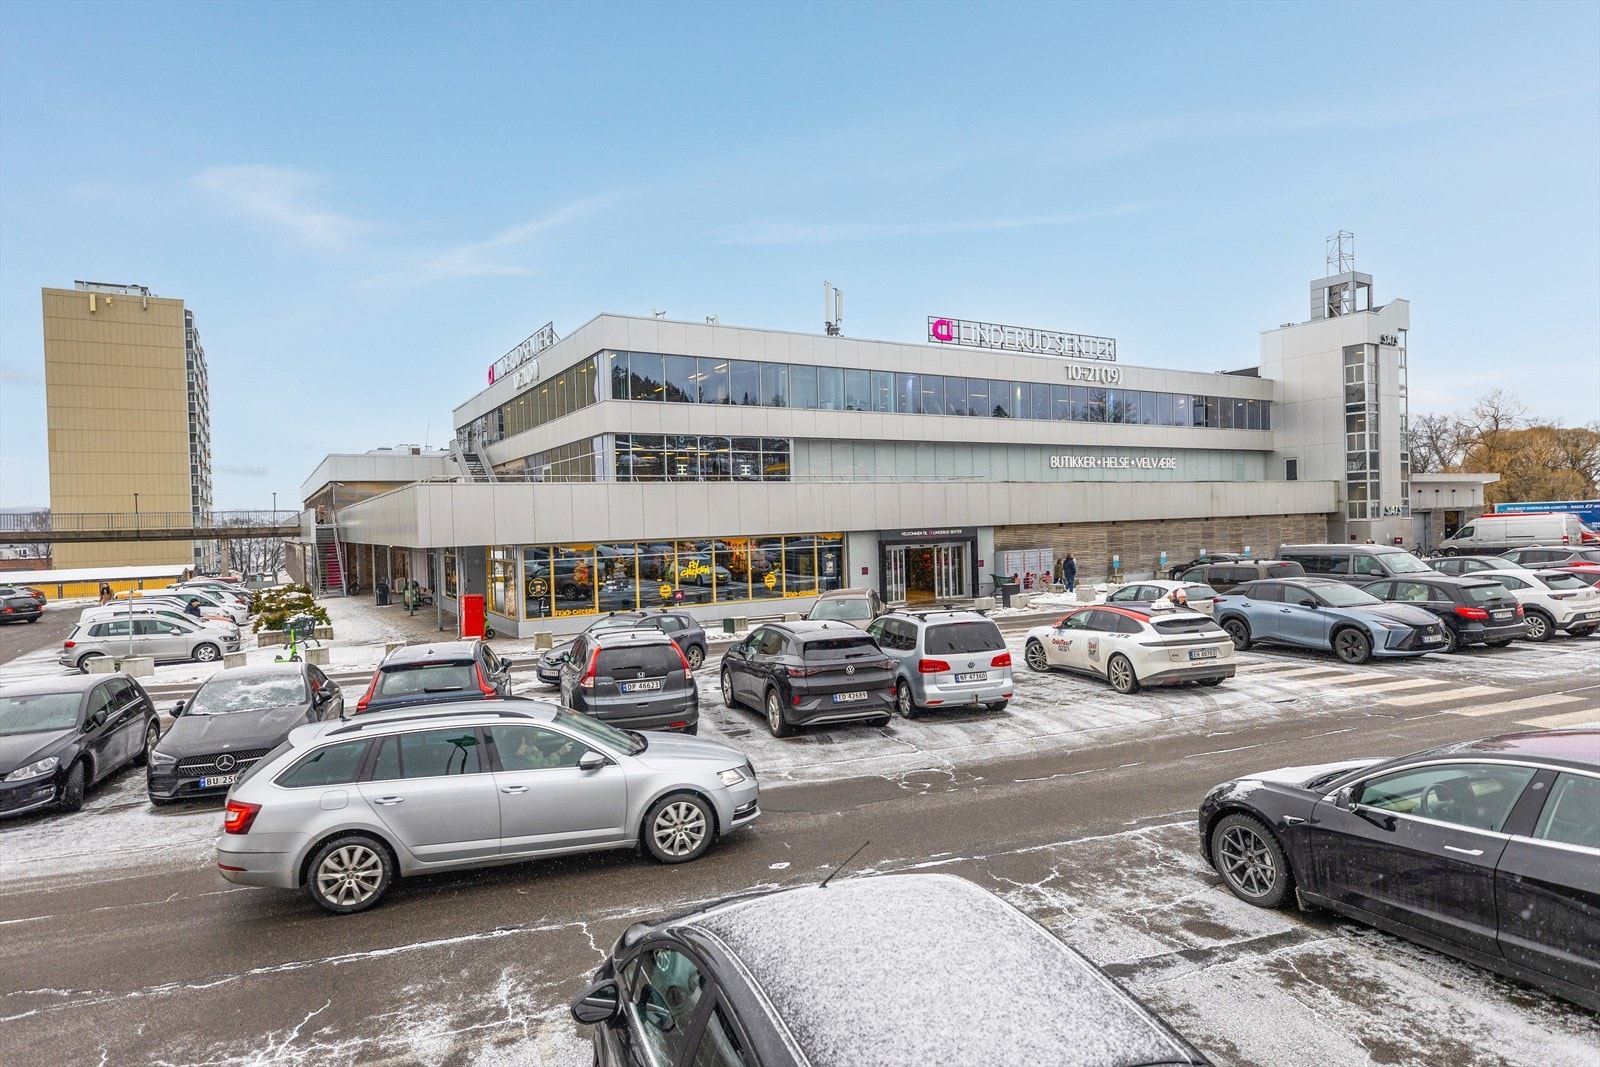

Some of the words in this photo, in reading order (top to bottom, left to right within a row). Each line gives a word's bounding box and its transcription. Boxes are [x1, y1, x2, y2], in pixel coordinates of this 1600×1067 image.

[959, 320, 1050, 351] LINDERUD
[1055, 332, 1115, 359] SENTER
[1050, 456, 1096, 468] BUTIKKER
[1102, 456, 1130, 468] HELSE
[1135, 457, 1176, 469] VELVÆRE
[1384, 504, 1401, 516] SATS
[680, 565, 710, 578] CHICKEN
[638, 681, 659, 689] 46623
[206, 777, 219, 785] BU
